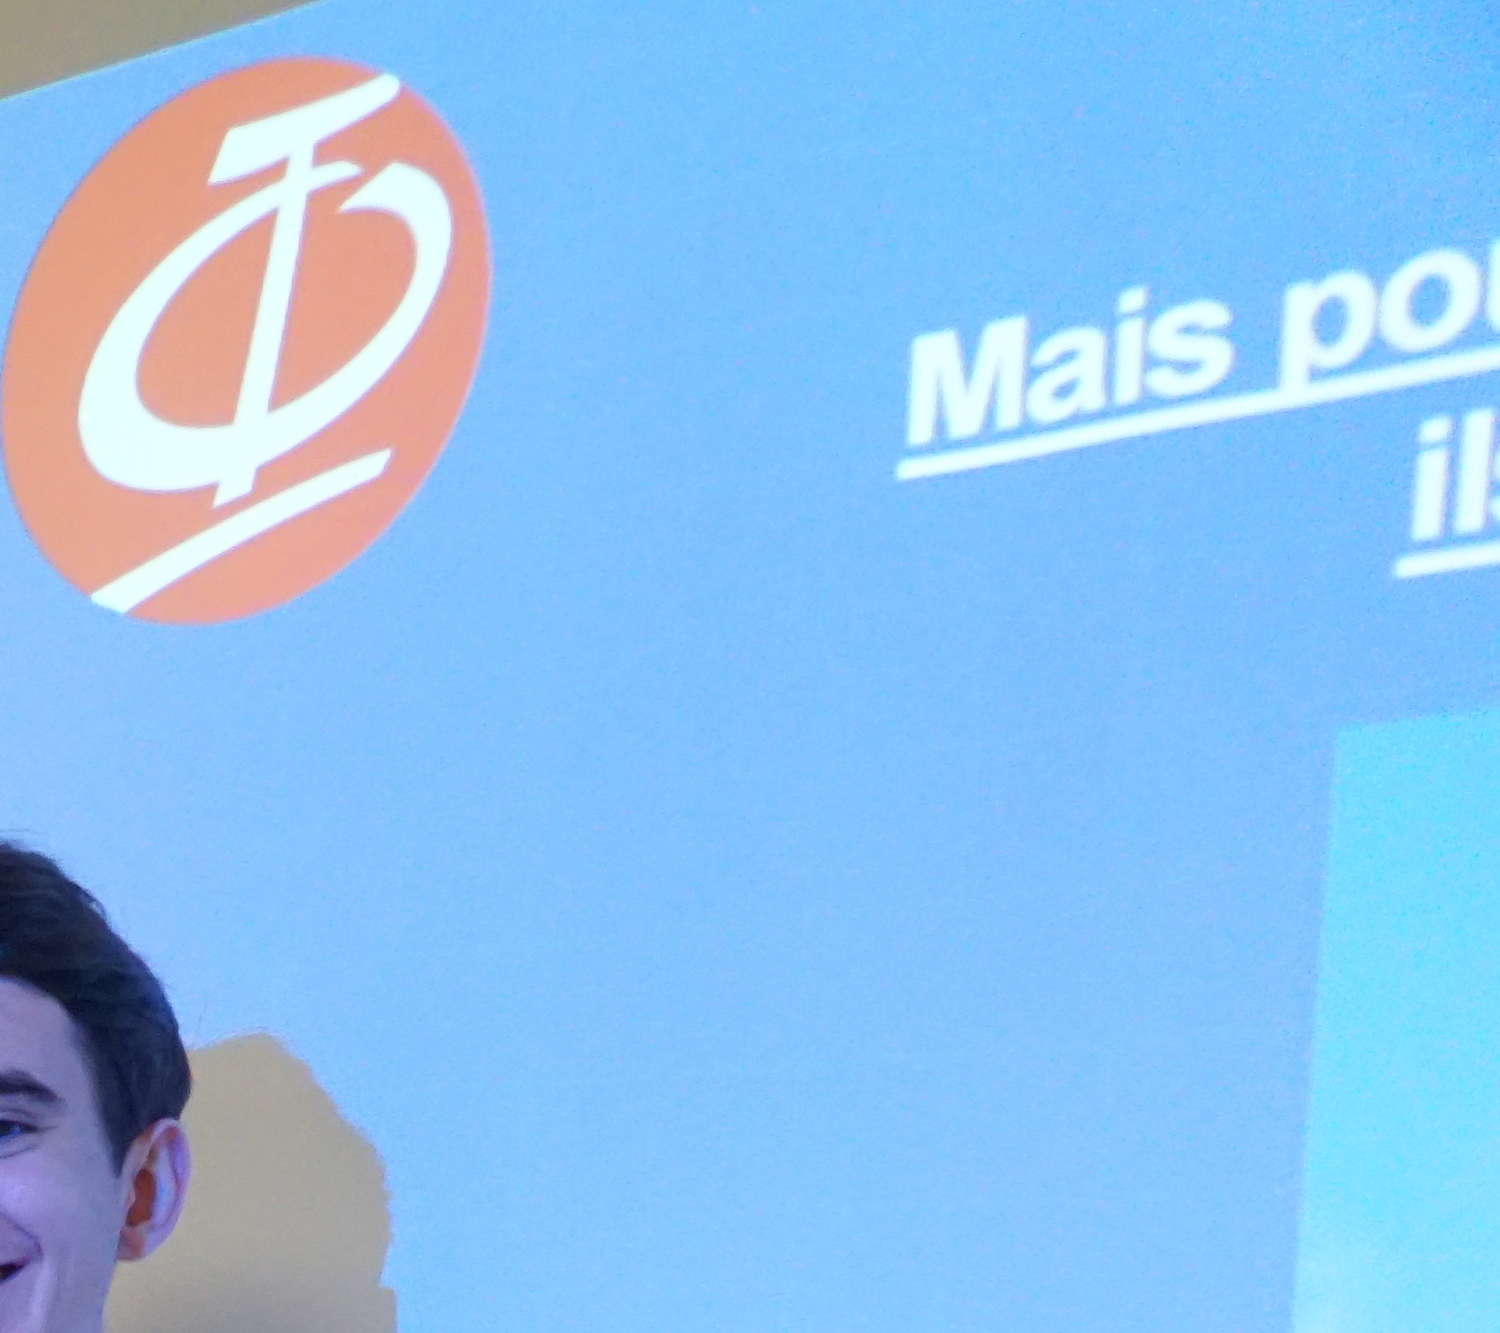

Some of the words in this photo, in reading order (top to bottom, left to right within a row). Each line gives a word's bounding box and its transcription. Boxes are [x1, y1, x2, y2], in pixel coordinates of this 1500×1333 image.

[905, 284, 1235, 450] Mais
[1278, 238, 1500, 400] po
[1409, 407, 1500, 543] il
